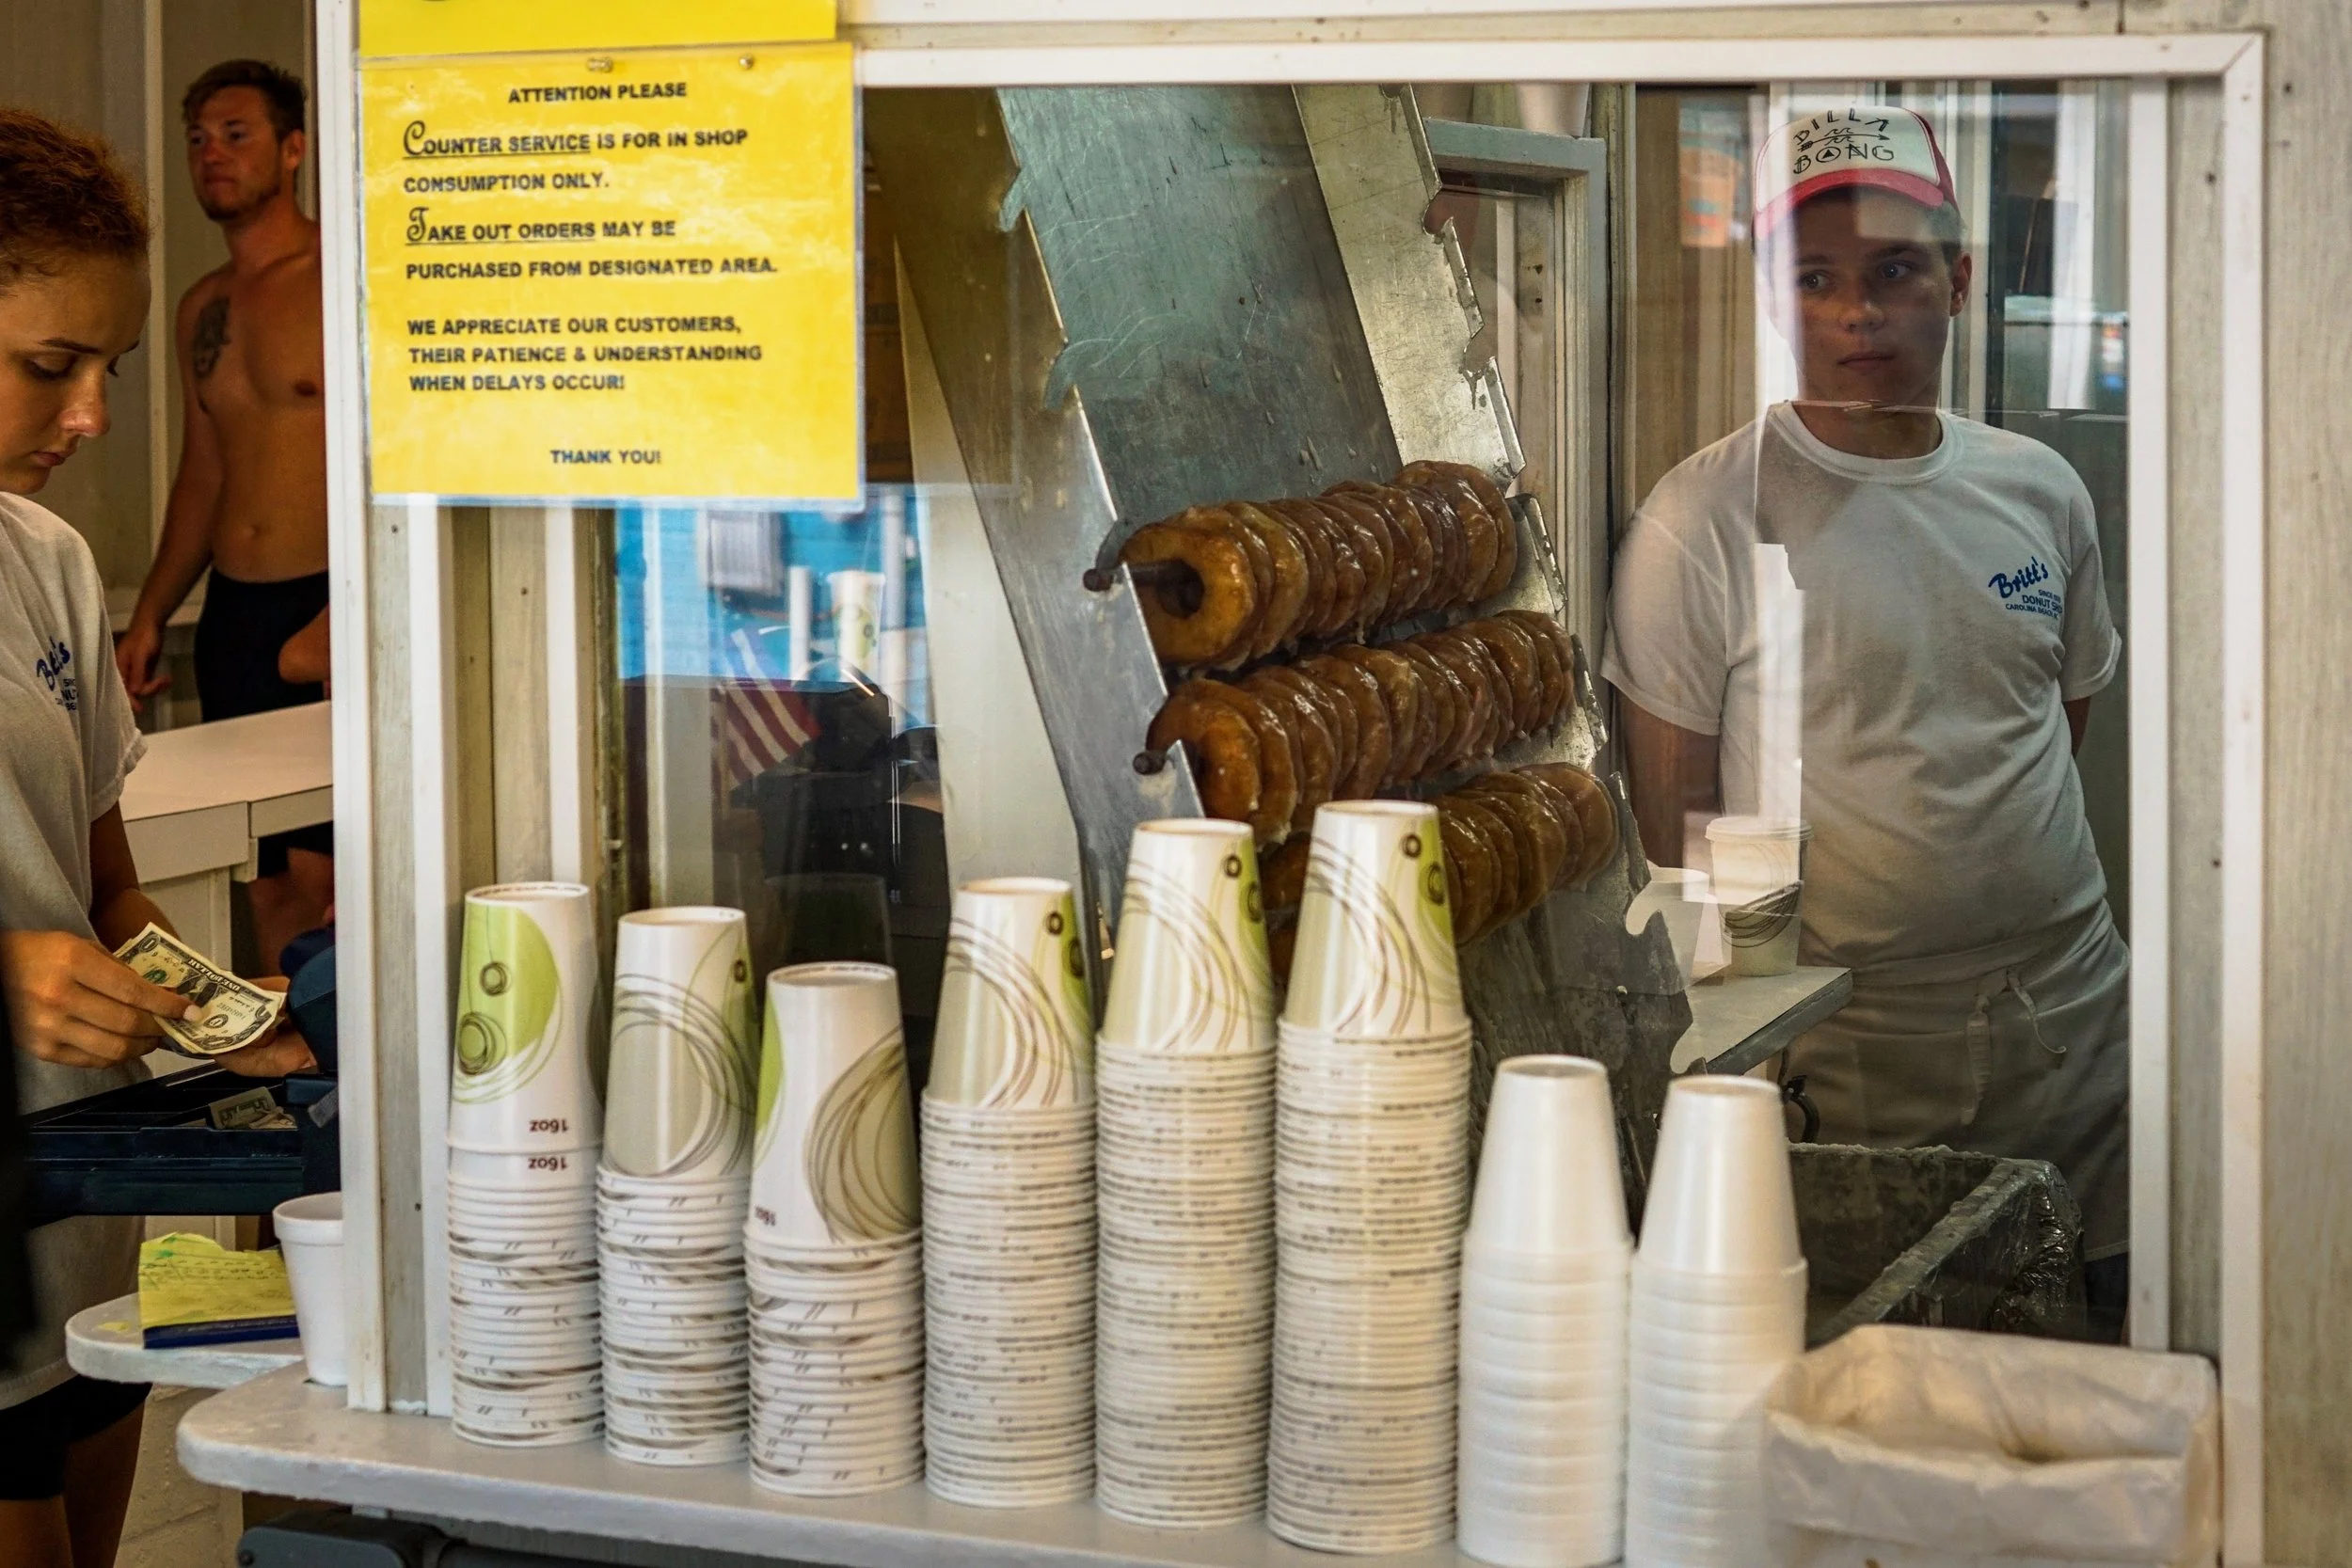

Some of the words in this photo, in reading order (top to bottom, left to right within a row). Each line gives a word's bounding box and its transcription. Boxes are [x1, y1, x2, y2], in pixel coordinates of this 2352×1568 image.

[508, 86, 612, 103] ATTENTION
[617, 82, 687, 99] PLEASE
[403, 119, 502, 156] COUNTER
[509, 135, 590, 153] SERVICE
[597, 134, 615, 150] IS
[622, 132, 660, 149] FOR
[667, 133, 688, 147] IN
[694, 129, 748, 147] SHOP
[404, 174, 546, 193] CONSUMPTION
[552, 173, 610, 189] ONLY.
[406, 206, 467, 243] TAKE
[472, 224, 512, 241] OUT
[517, 222, 596, 239] ORDERS
[602, 221, 644, 237] MAY
[651, 220, 675, 237] BE
[405, 261, 522, 279] PURCHASED
[529, 261, 581, 277] FROM
[589, 259, 713, 276] DESIGNATED
[721, 258, 778, 273] AREA.
[407, 319, 437, 336] WE
[442, 318, 561, 335] APPRECIATE
[567, 318, 608, 333] OUR
[614, 316, 742, 334] CUSTOMERS,
[409, 347, 466, 364] THEIR
[472, 347, 565, 362] PATIENCE
[574, 347, 586, 362] &
[594, 345, 762, 361] UNDERSTANDING
[409, 375, 466, 391] WHEN
[472, 375, 547, 390] DELAYS
[552, 375, 624, 390] OCCUR!
[550, 450, 611, 464] THANK
[1988, 556, 2049, 598] Britt's
[2005, 603, 2037, 612] CAROLINA
[2022, 594, 2051, 609] DONUT
[188, 958, 223, 984] DOLLAR
[221, 978, 242, 993] ONE
[529, 1118, 569, 1133] 16oz
[527, 1157, 568, 1171] 16oz
